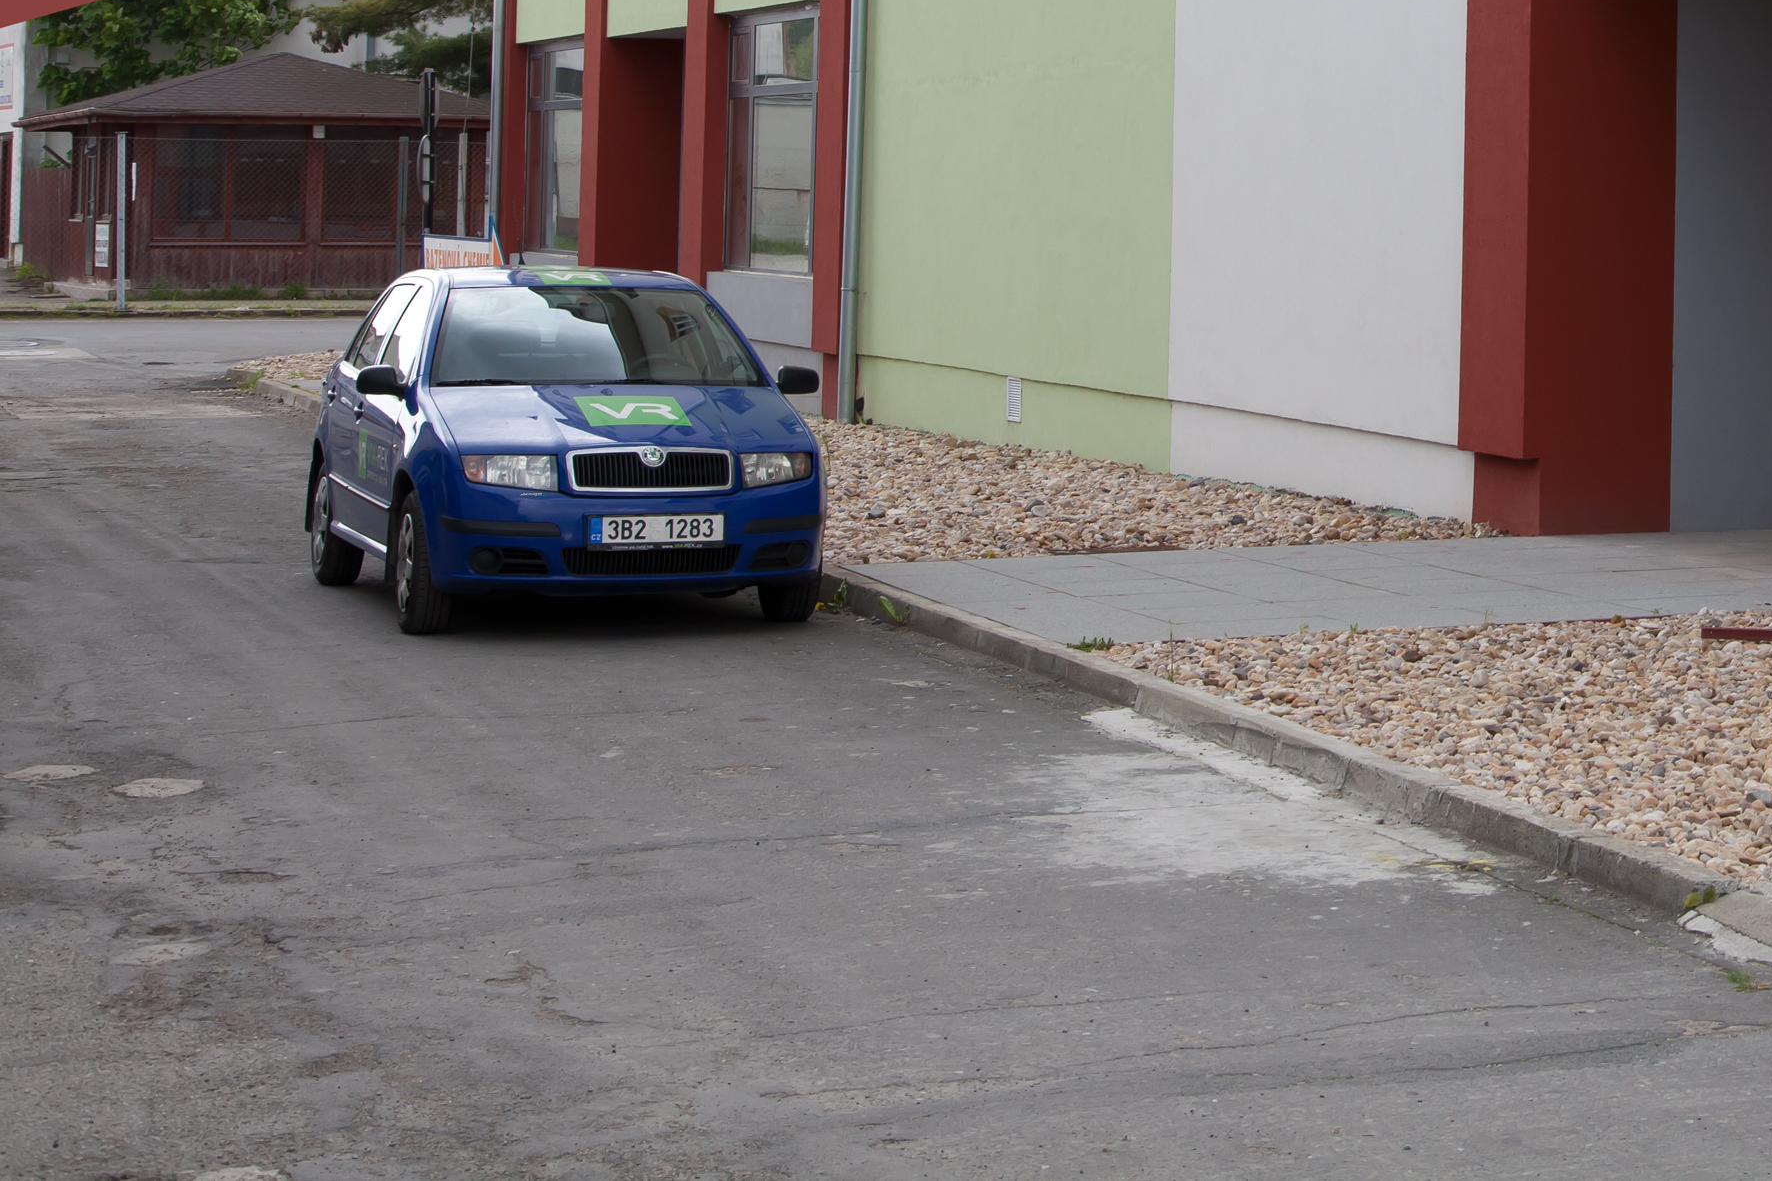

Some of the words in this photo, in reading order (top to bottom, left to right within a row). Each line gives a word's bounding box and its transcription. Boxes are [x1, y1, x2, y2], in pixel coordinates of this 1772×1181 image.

[589, 402, 680, 420] VR
[607, 519, 647, 540] 3B2
[664, 518, 714, 539] 1283
